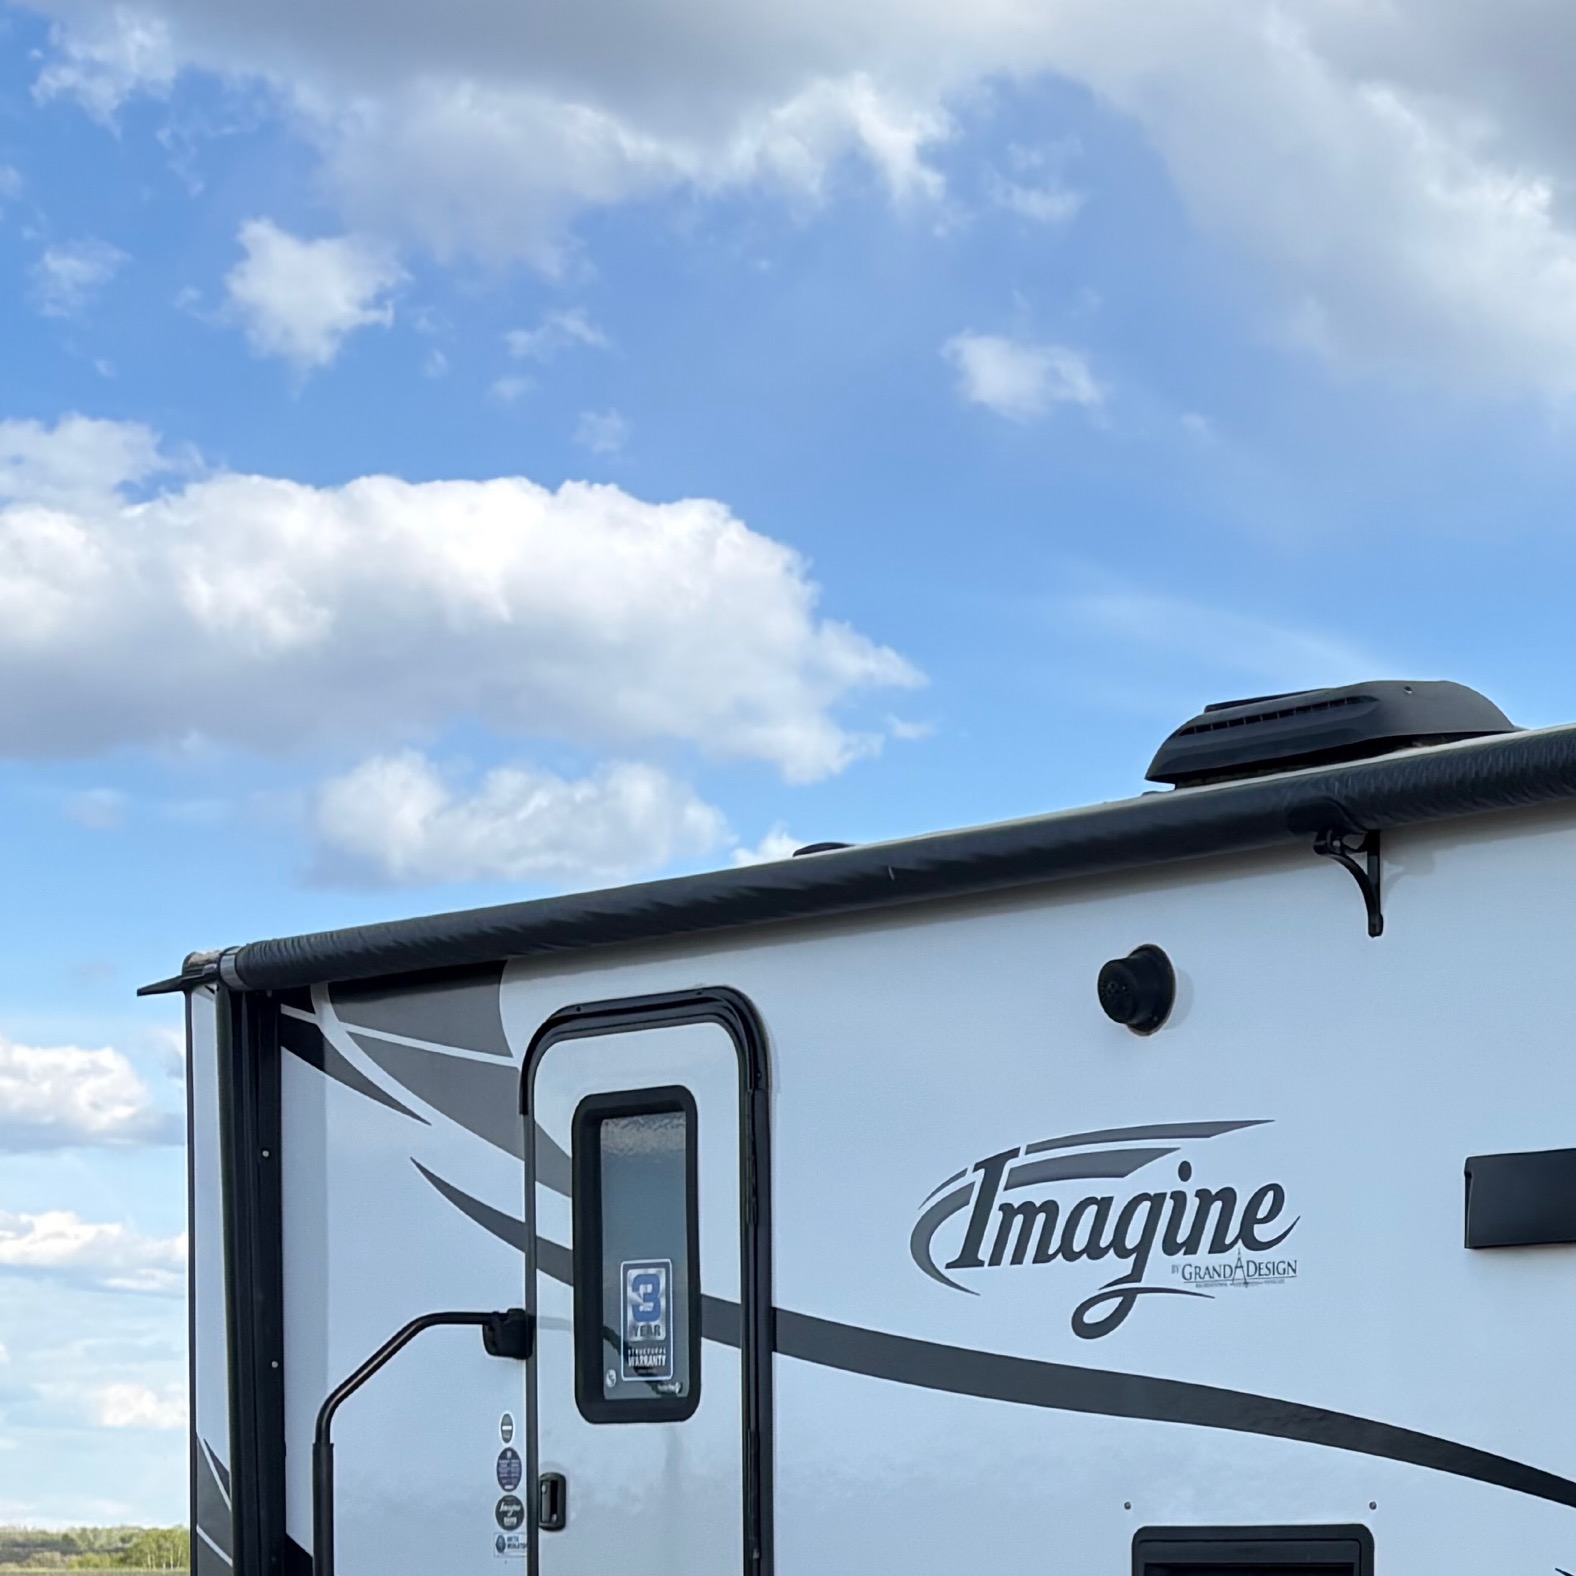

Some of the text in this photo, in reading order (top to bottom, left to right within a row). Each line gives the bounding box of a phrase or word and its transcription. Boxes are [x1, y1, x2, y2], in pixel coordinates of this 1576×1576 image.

[945, 1146, 1301, 1339] Imagine
[1181, 1263, 1234, 1281] GRAND
[1246, 1259, 1298, 1278] DESIGN
[631, 1273, 661, 1323] 3
[634, 1324, 662, 1337] YEAR
[627, 1355, 667, 1368] WARRANTY
